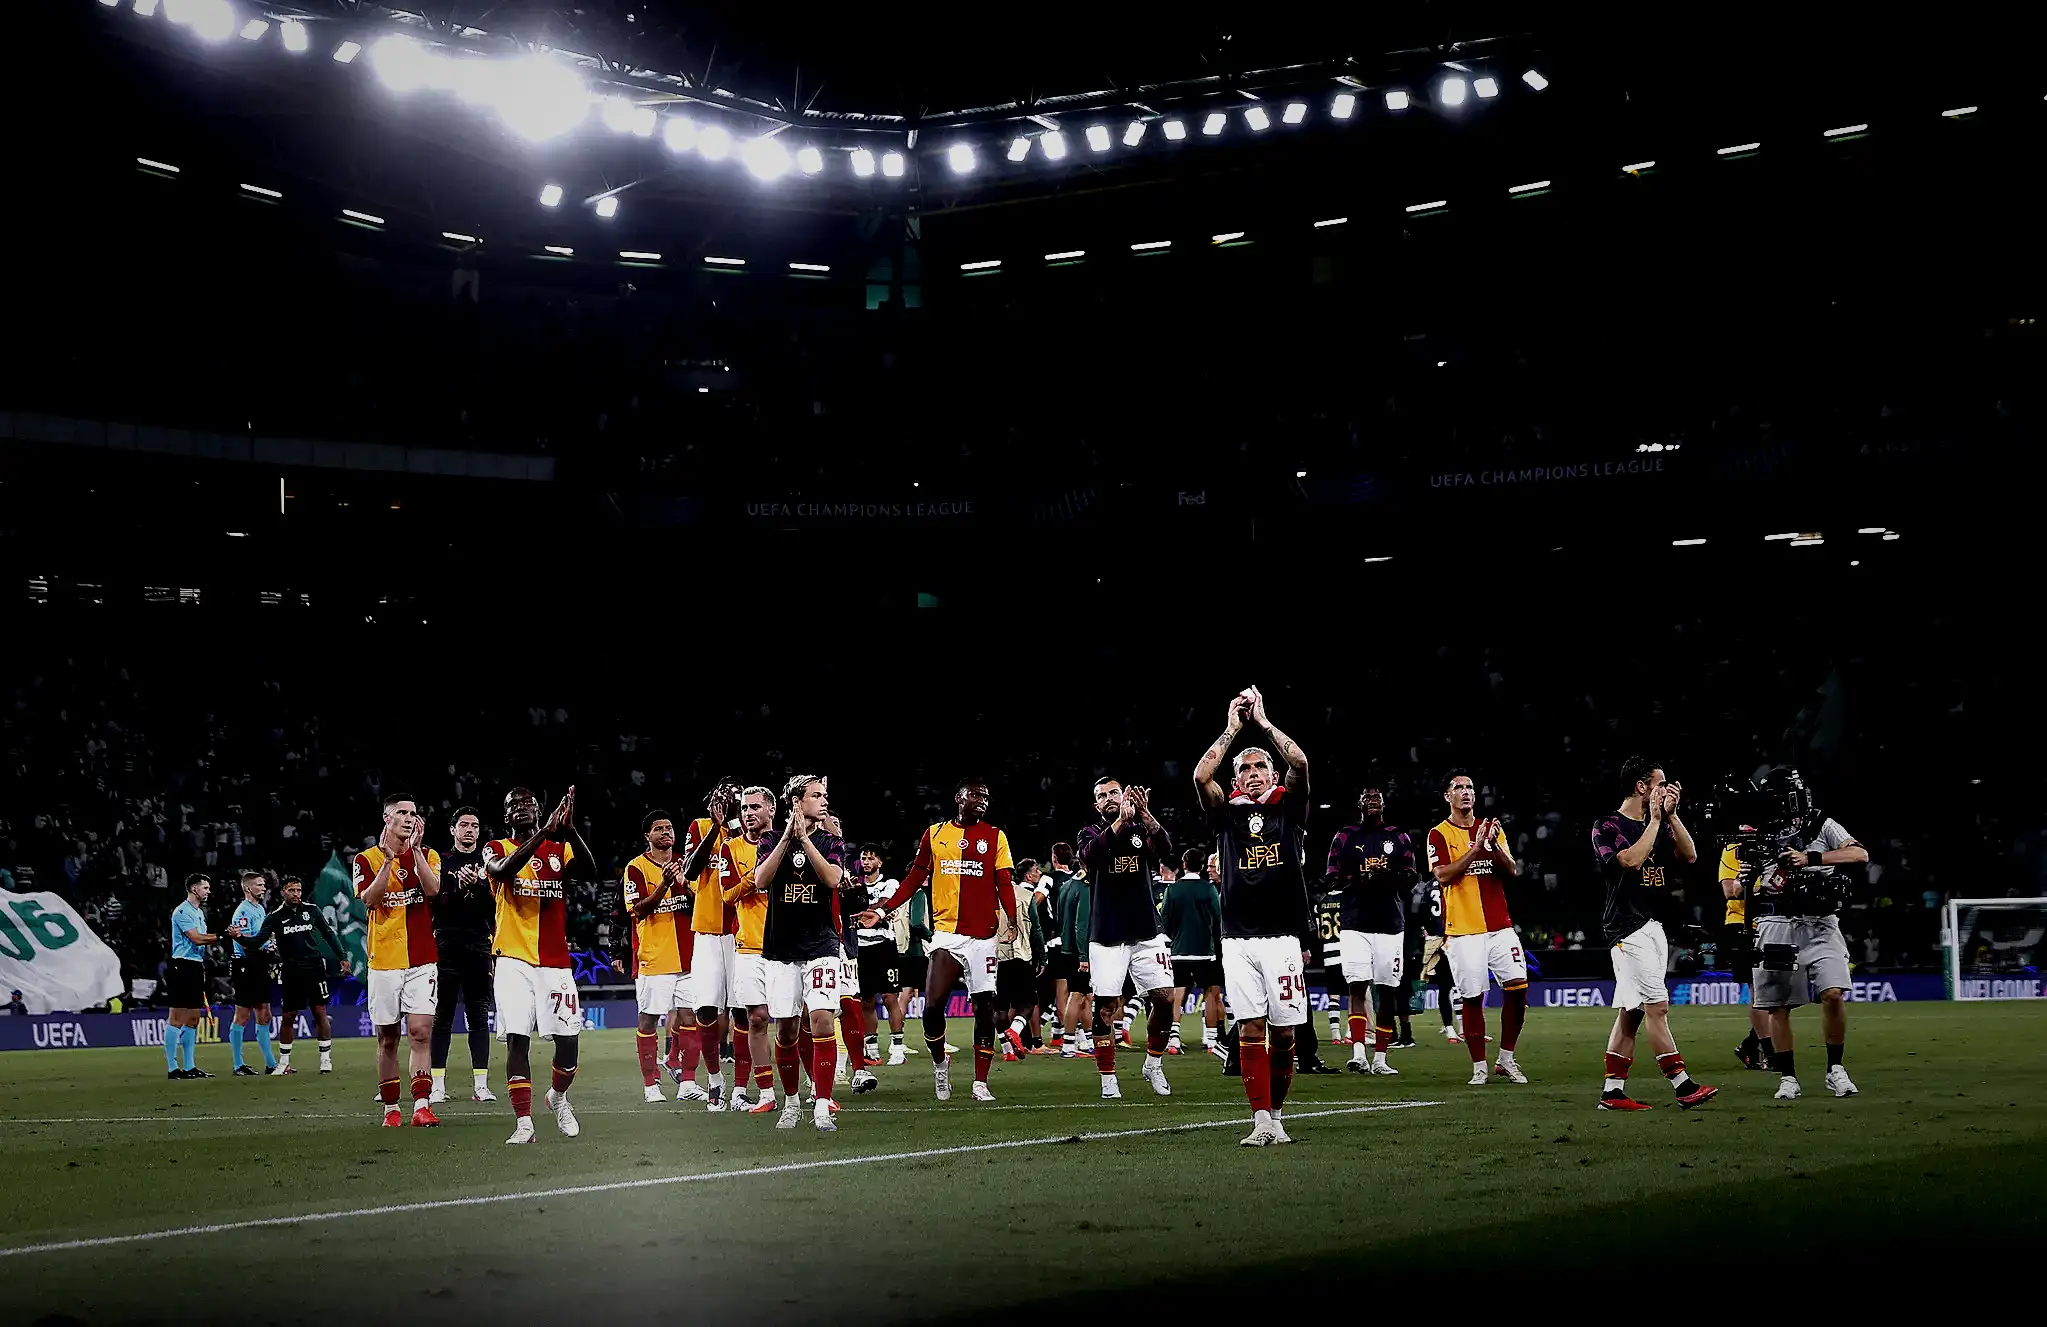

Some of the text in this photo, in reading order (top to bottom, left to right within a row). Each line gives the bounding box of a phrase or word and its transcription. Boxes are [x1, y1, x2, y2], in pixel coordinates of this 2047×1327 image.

[1430, 457, 1667, 488] UEFA CHAMPIONS LEAGUE
[747, 500, 975, 517] UEFA CHAMPIONS LEAGUE
[1114, 855, 1139, 864] NEXT
[1246, 843, 1281, 858] NEXT
[1239, 855, 1284, 869] LEVEL
[784, 883, 817, 894] NEXT
[283, 923, 314, 935] Betano
[812, 968, 836, 989] 83
[1278, 974, 1305, 1001] 34
[550, 992, 577, 1015] 74
[1543, 987, 1607, 1007] UEFA
[32, 1022, 89, 1047] UEFA
